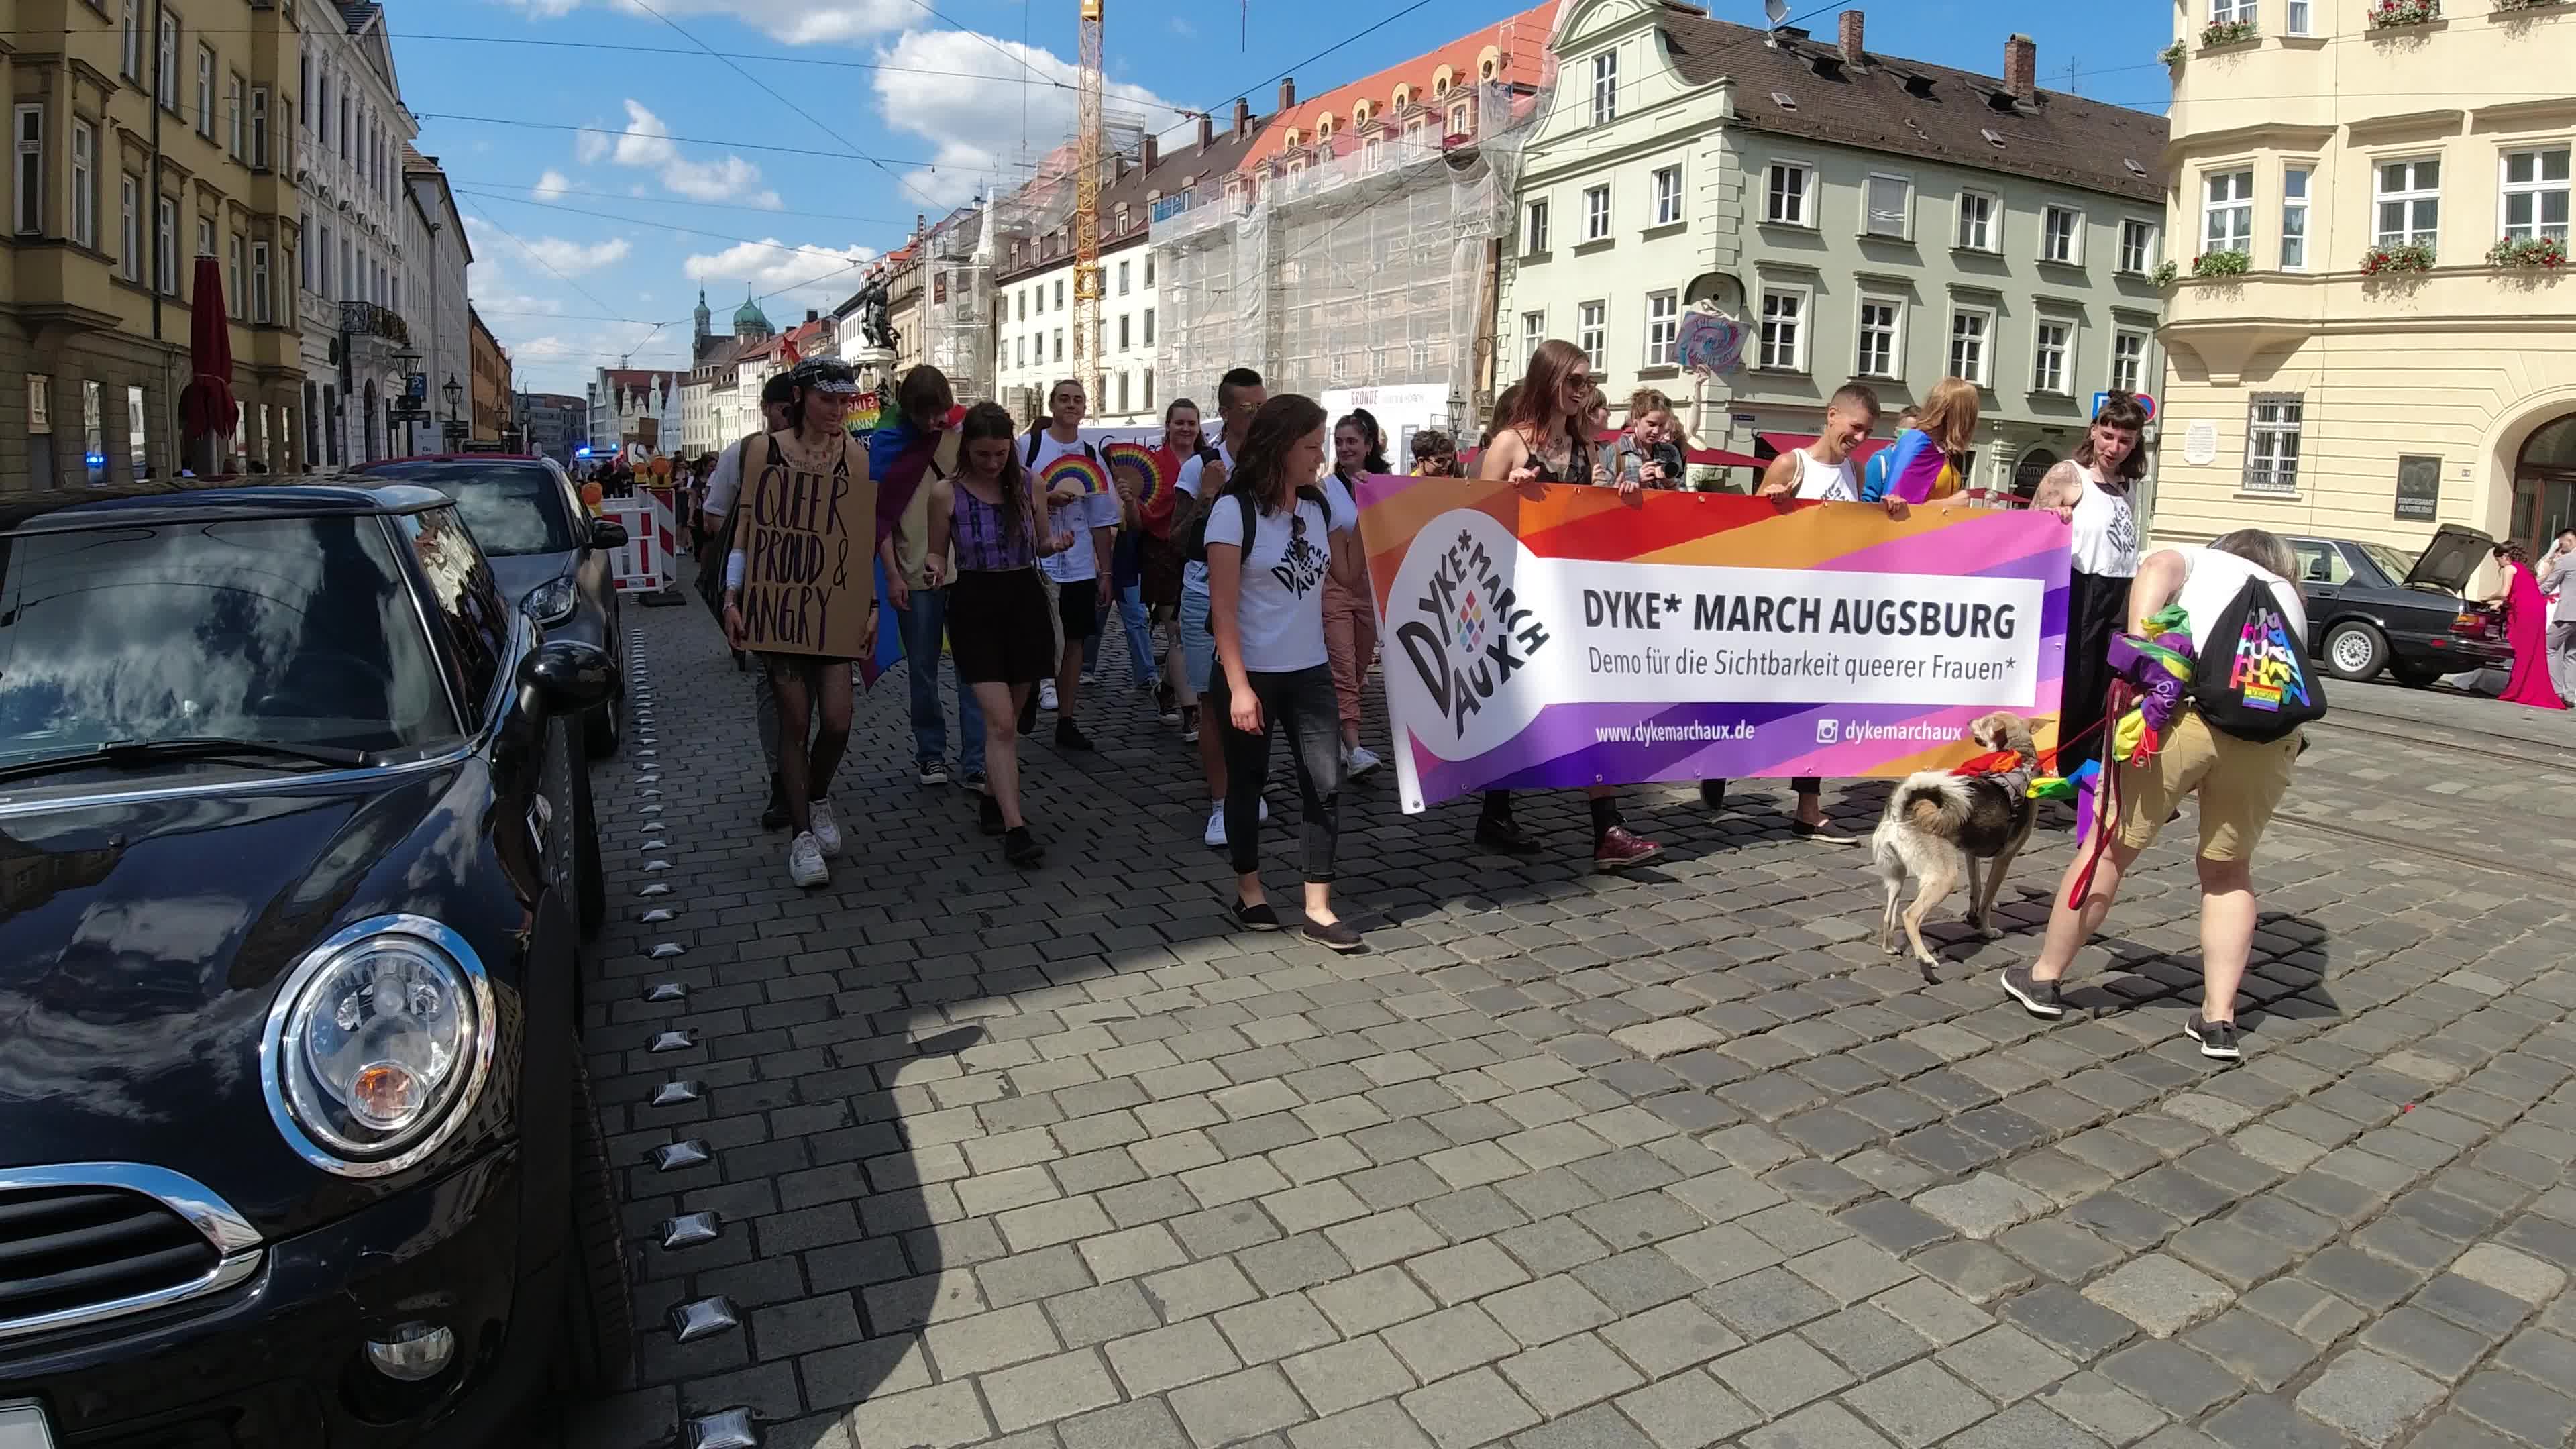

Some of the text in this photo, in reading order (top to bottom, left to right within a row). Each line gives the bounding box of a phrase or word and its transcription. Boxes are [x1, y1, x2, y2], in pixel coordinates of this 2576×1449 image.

[755, 466, 849, 537] QUEER
[751, 528, 849, 591] PROUD &
[1296, 563, 1324, 600] AUX
[741, 586, 832, 652] ANGRY
[1469, 542, 1550, 657] MARCH
[1694, 594, 1821, 634] MARCH
[1829, 598, 2015, 639] AUGSBURG
[1454, 634, 1526, 741] AUX
[1589, 647, 1641, 674] Demo
[1646, 647, 1670, 675] für
[1677, 647, 1707, 675] die
[1714, 649, 1839, 677] Sichtbarkeit
[1845, 657, 1926, 684] queerer
[1595, 720, 1755, 747] www.dykemarchaux.de
[1845, 719, 1962, 743] dykemarchaux
